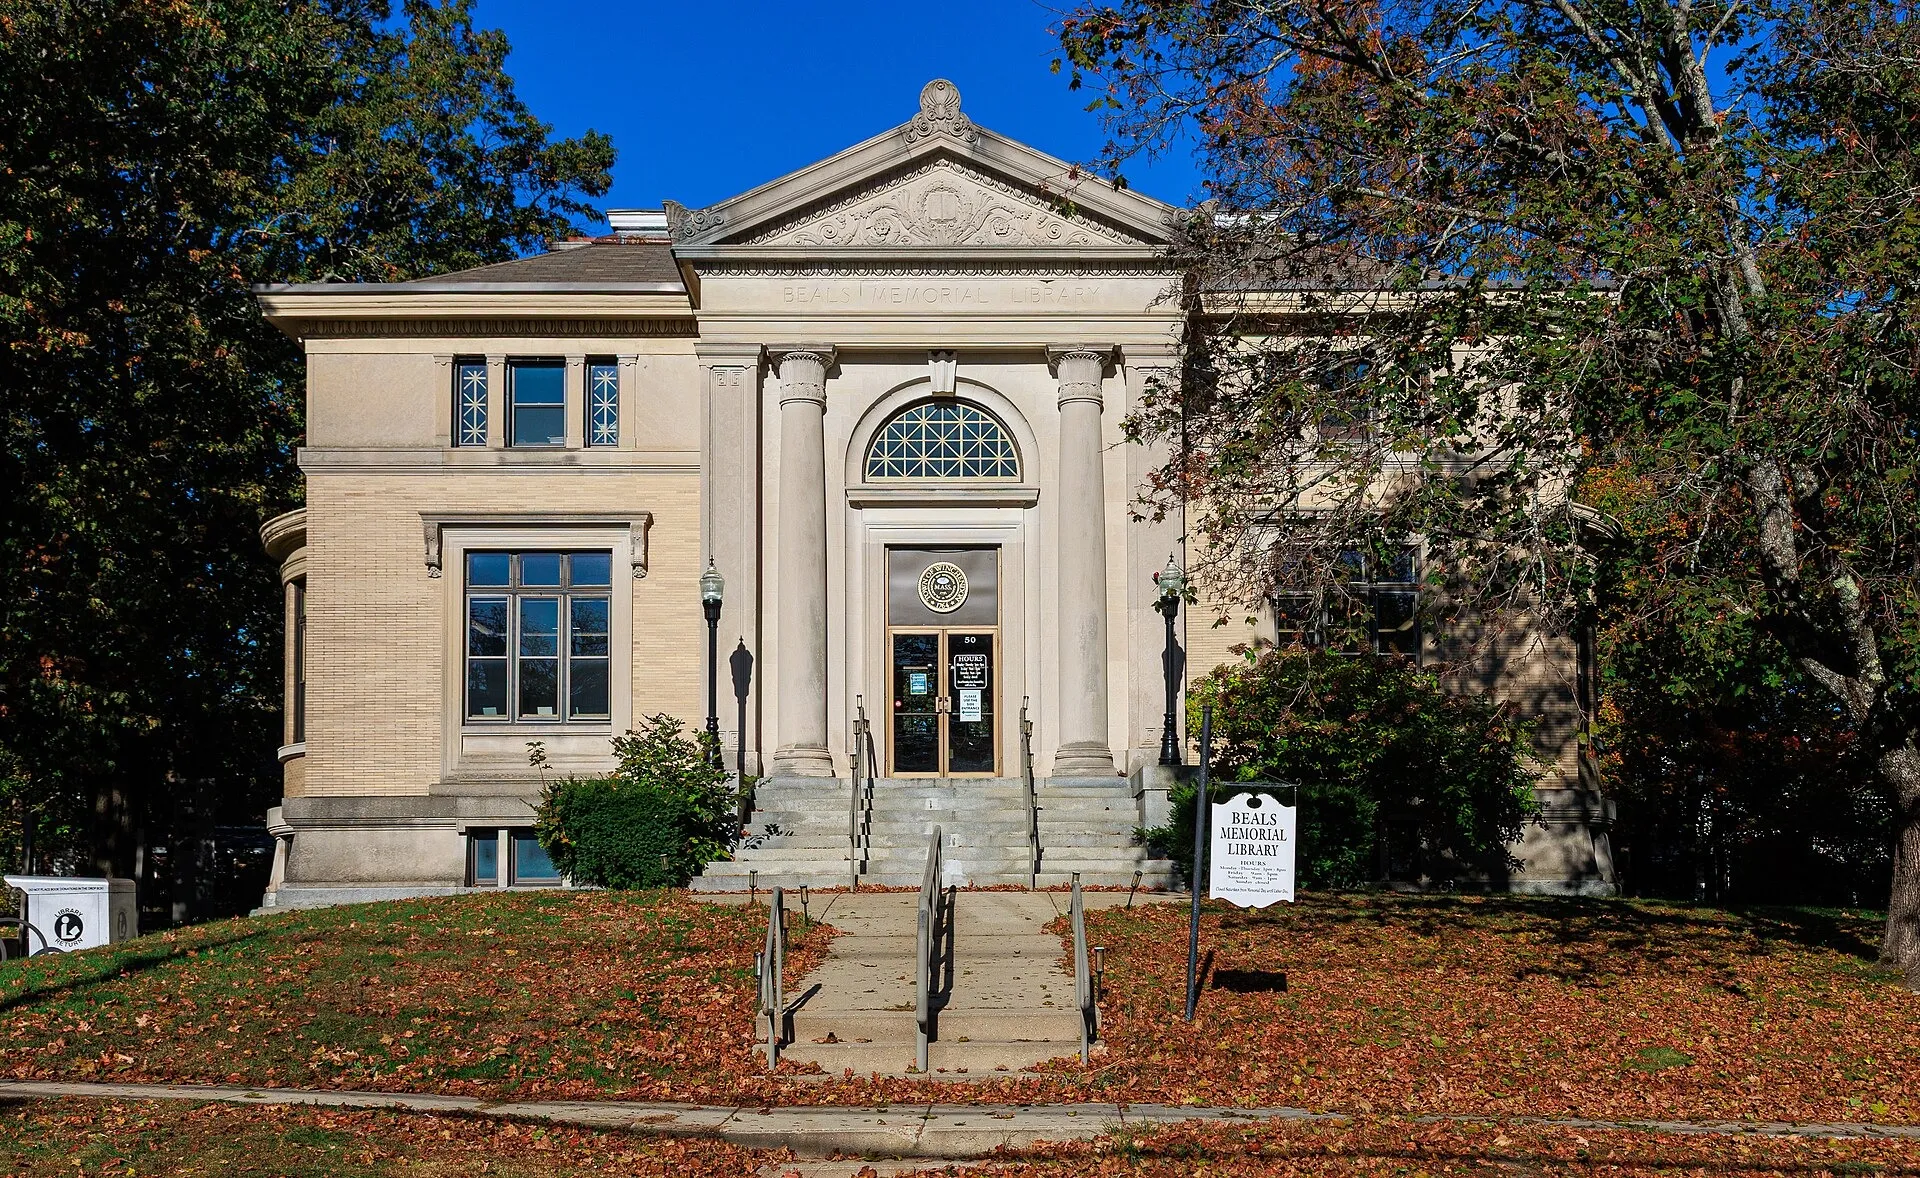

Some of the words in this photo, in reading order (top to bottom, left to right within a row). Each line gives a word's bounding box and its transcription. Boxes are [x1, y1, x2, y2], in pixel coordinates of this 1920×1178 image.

[783, 286, 851, 303] BEALS
[872, 287, 989, 304] MEMORIAL
[1010, 286, 1101, 304] LIBRARY
[921, 578, 931, 602] TOWN
[926, 568, 934, 579] OF
[933, 564, 966, 603] WINCHENDON
[964, 636, 976, 644] 50
[1231, 811, 1277, 826] BEALS
[1220, 827, 1287, 841] MEMORIAL
[1227, 843, 1279, 857] LIBRARY
[54, 907, 84, 918] LIBRARY
[54, 938, 84, 948] RETURN
